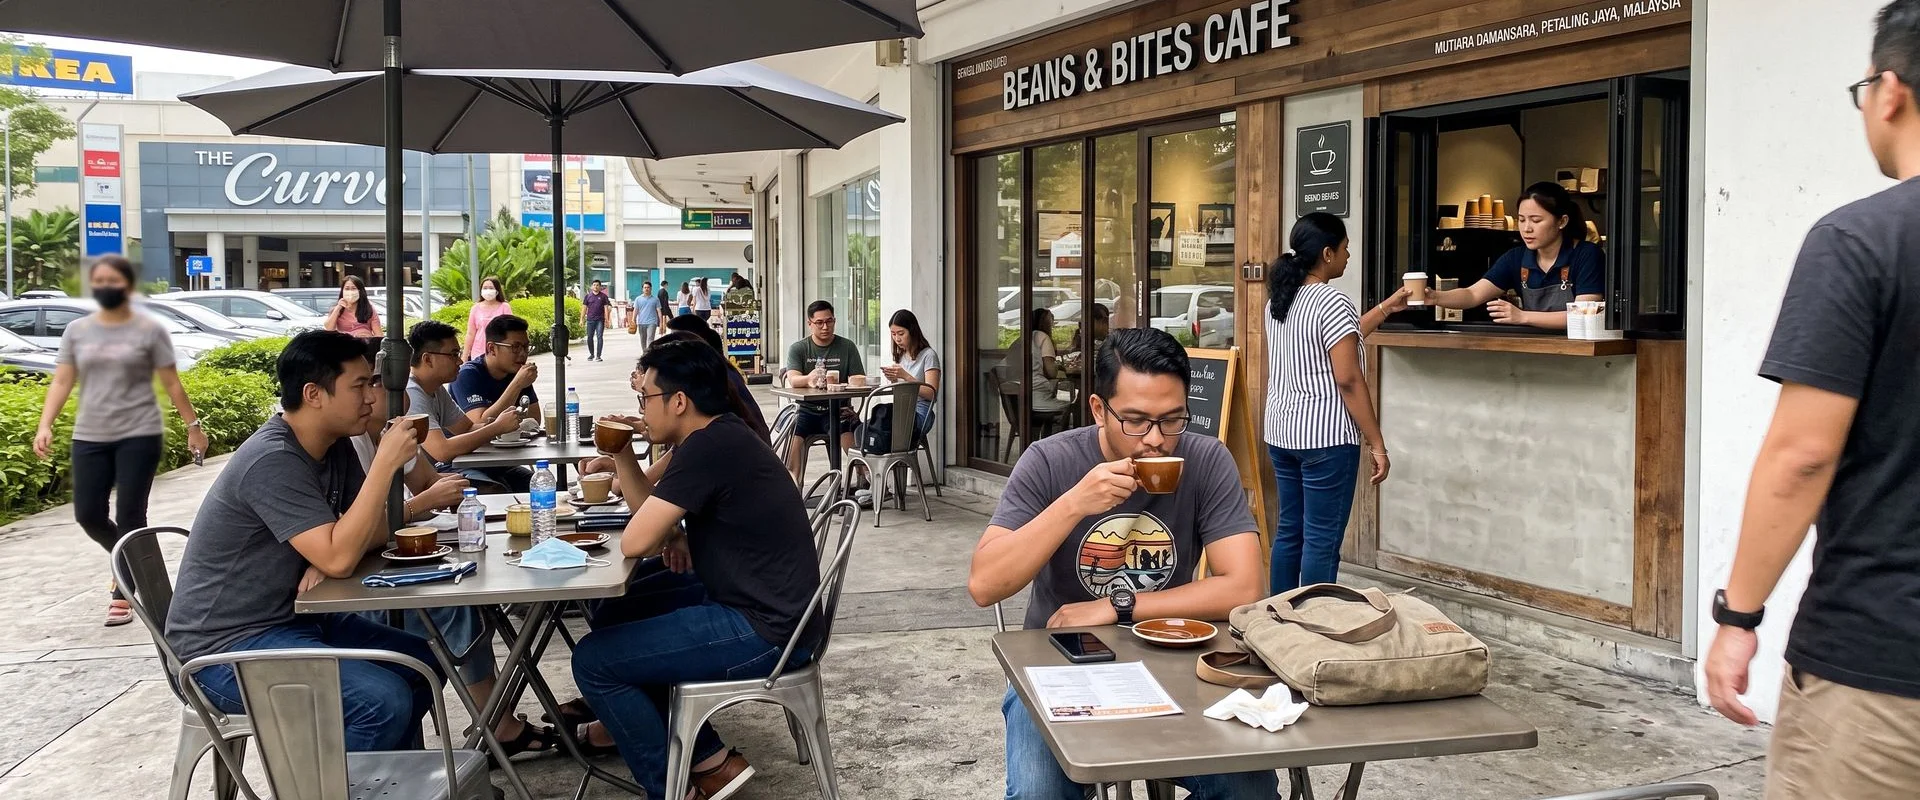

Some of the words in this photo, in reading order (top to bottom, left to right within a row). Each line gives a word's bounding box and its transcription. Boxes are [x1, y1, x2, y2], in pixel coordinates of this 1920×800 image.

[1435, 36, 1474, 54] MUTIARA
[1476, 23, 1538, 46] DAMANSARA,
[1541, 12, 1589, 34] PETALING
[1591, 6, 1620, 24] JAYA,
[1623, 0, 1681, 18] MALAYSIA
[1003, 54, 1076, 111] BEANS
[1083, 48, 1102, 92] &
[1111, 22, 1192, 86] BITES
[1204, 0, 1291, 64] CAFE
[195, 150, 233, 166] THE
